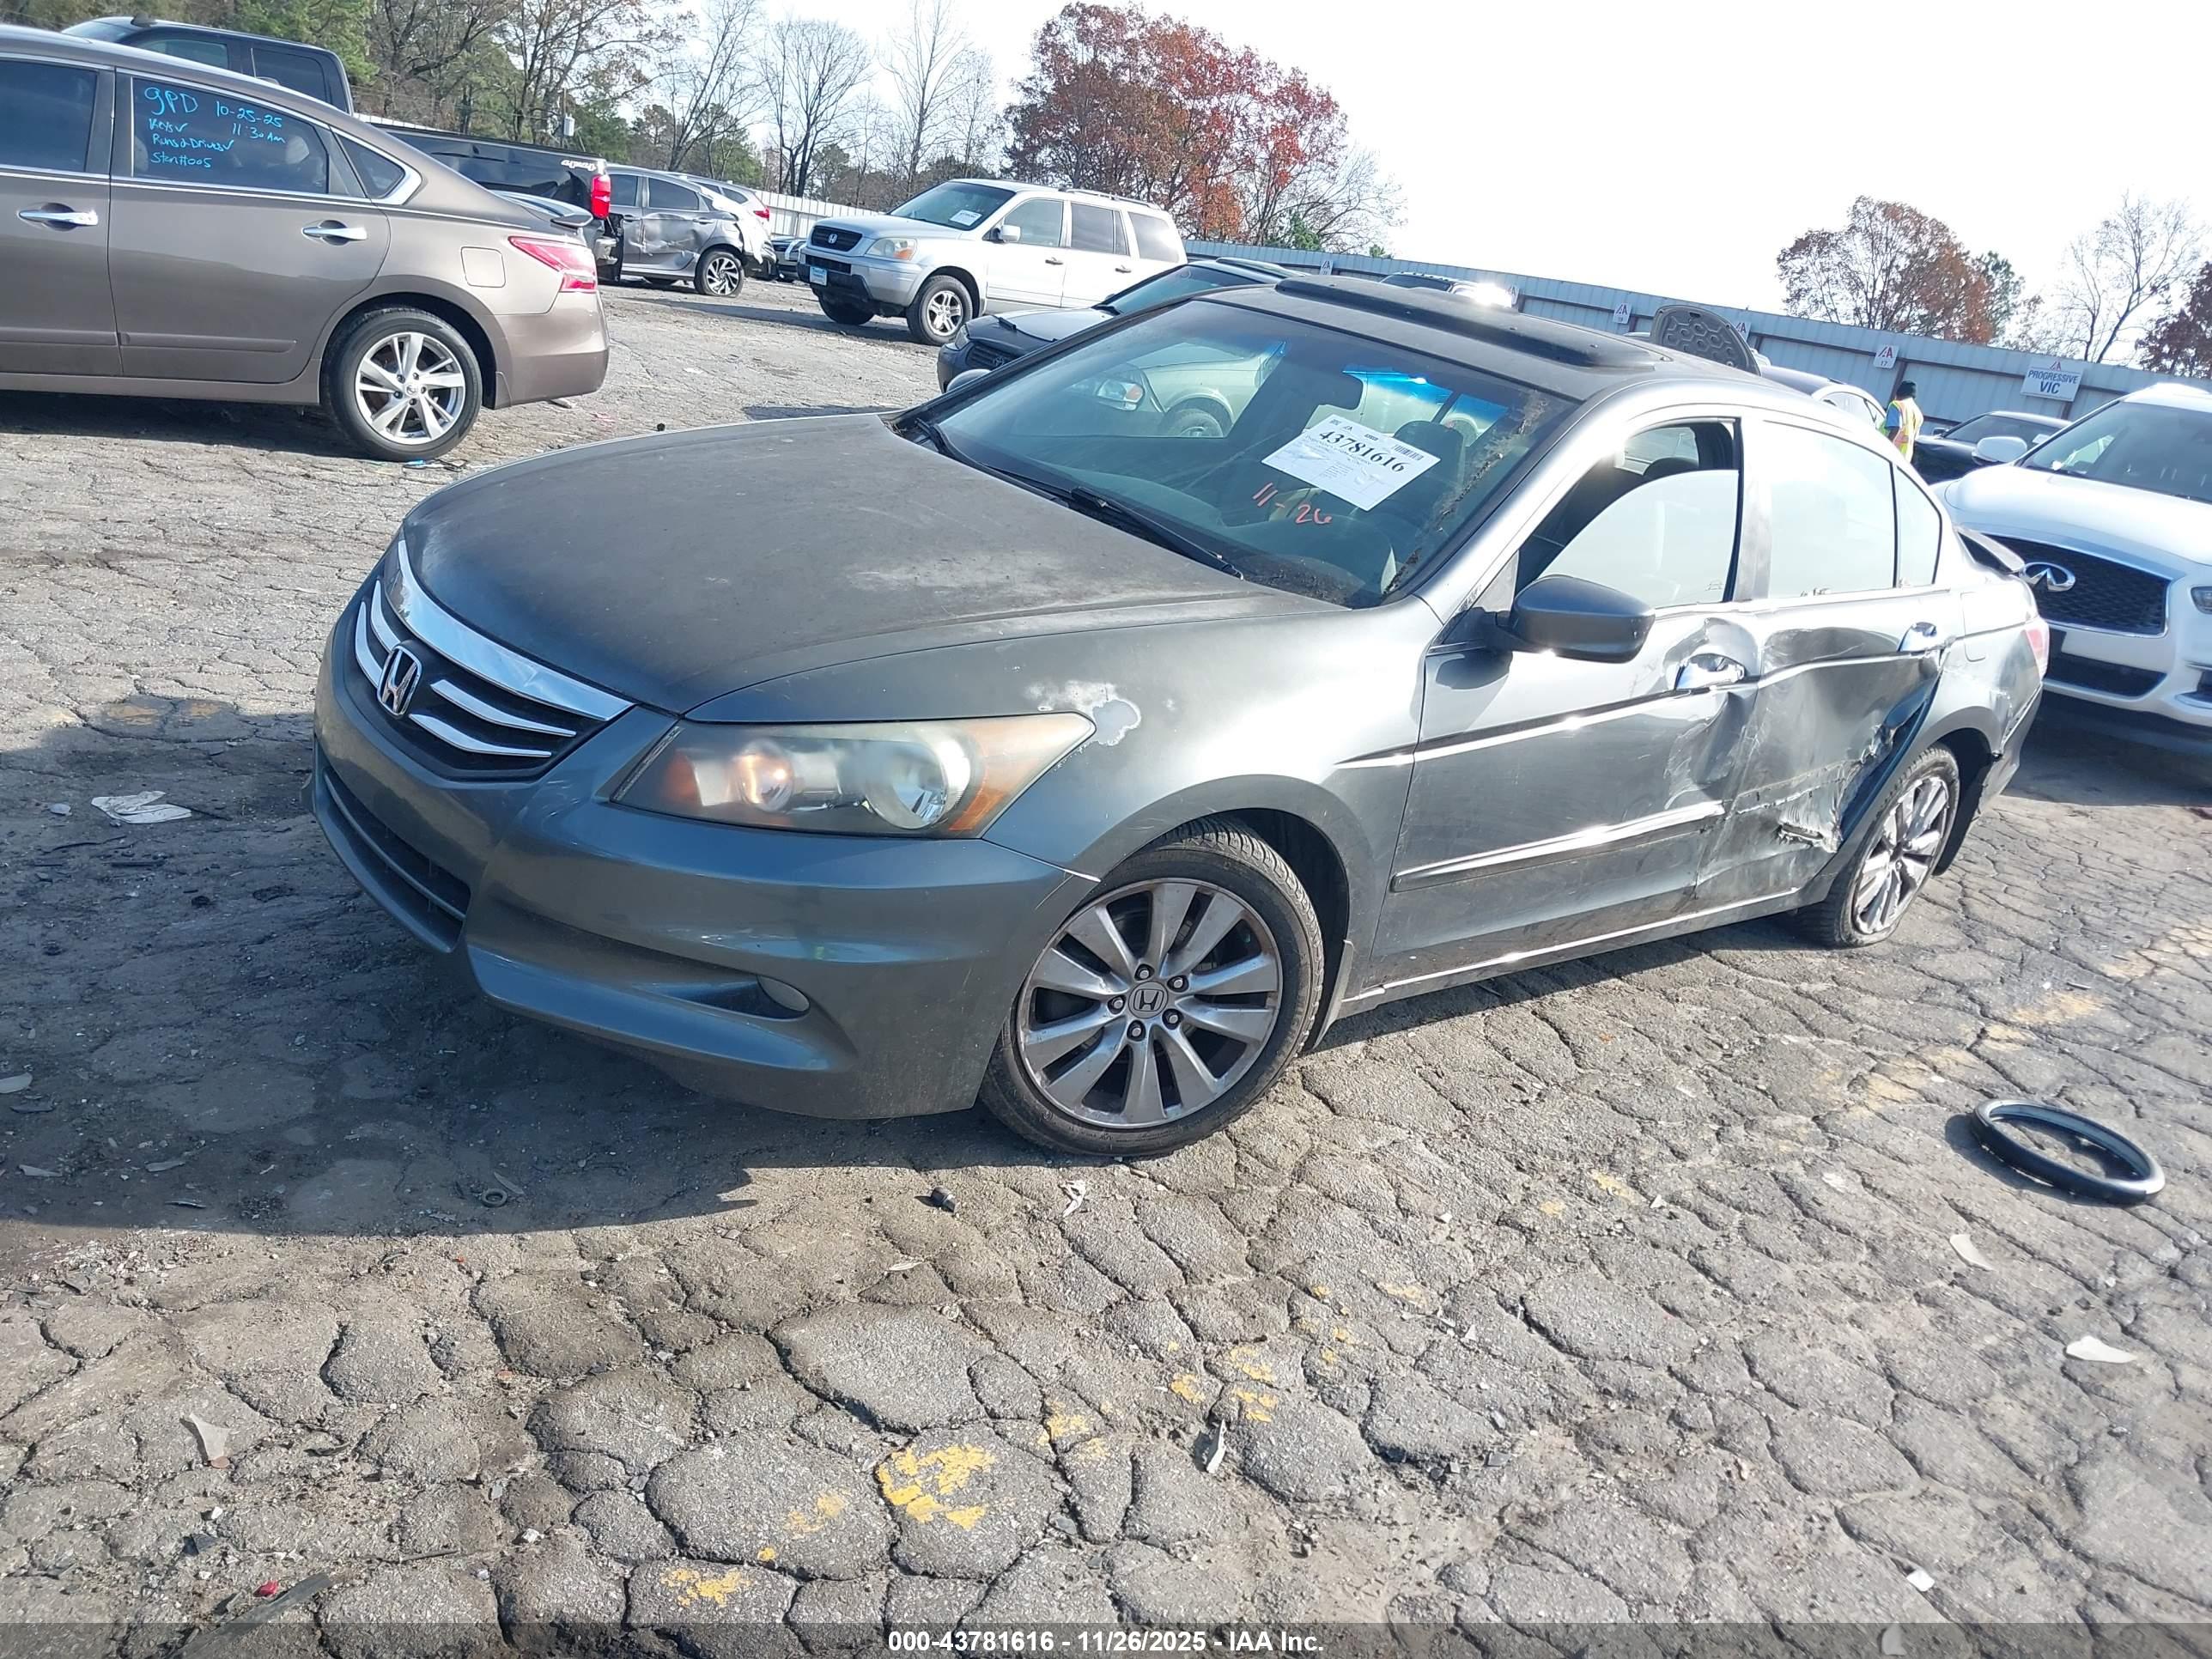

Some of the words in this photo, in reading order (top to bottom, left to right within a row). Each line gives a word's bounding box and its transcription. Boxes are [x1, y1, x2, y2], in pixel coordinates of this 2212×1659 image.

[216, 100, 283, 128] 10-25-25
[2027, 369, 2079, 384] PROGRESSIVE
[2039, 380, 2061, 394] VIC
[1319, 431, 1410, 471] 43781616
